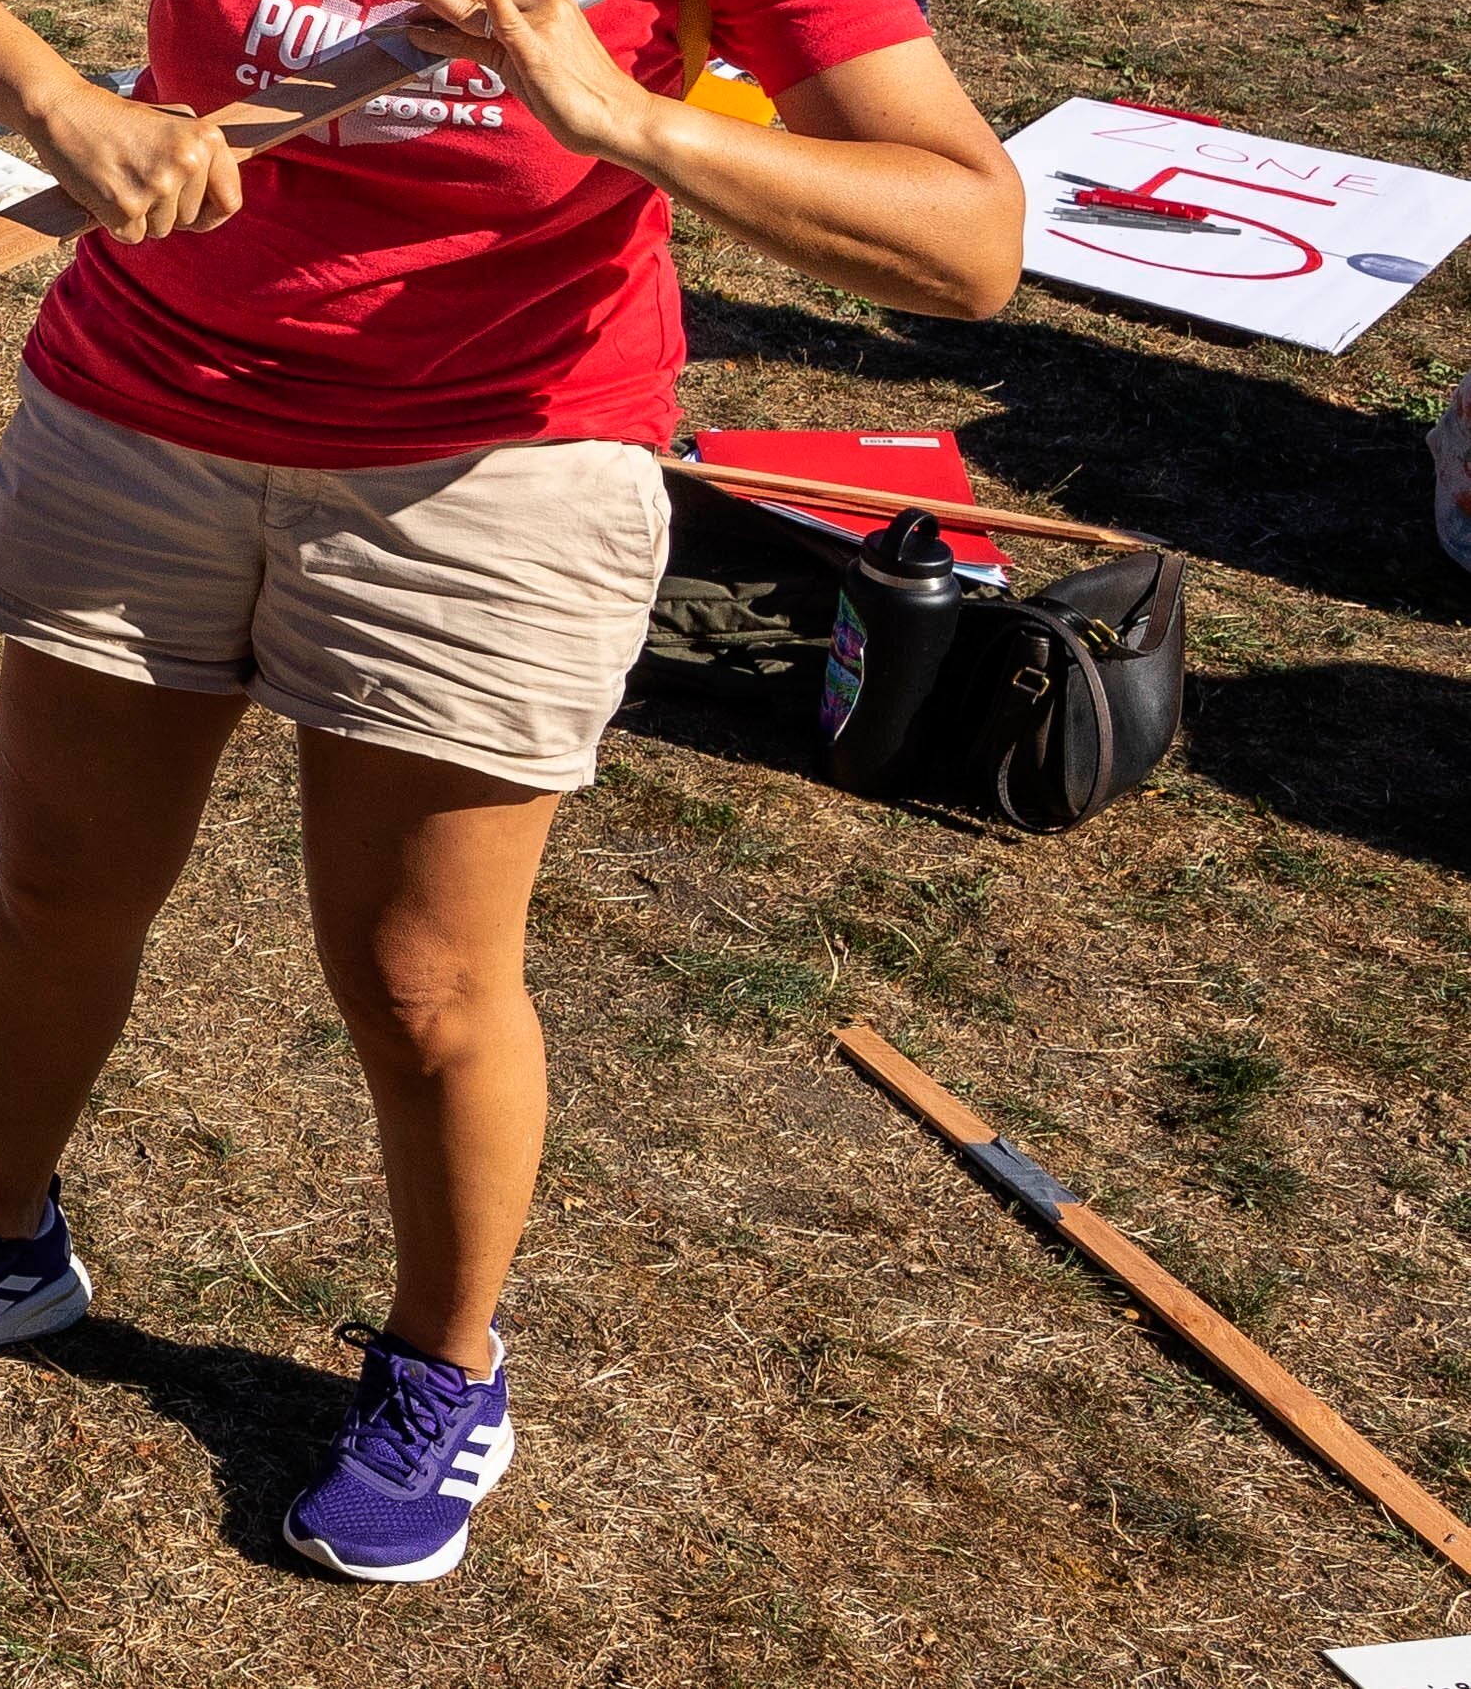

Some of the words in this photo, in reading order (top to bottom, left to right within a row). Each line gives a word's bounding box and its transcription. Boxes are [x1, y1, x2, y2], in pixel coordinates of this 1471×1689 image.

[364, 95, 504, 128] BOOKS
[1089, 102, 1380, 197] ZONE
[1045, 166, 1337, 280] 5
